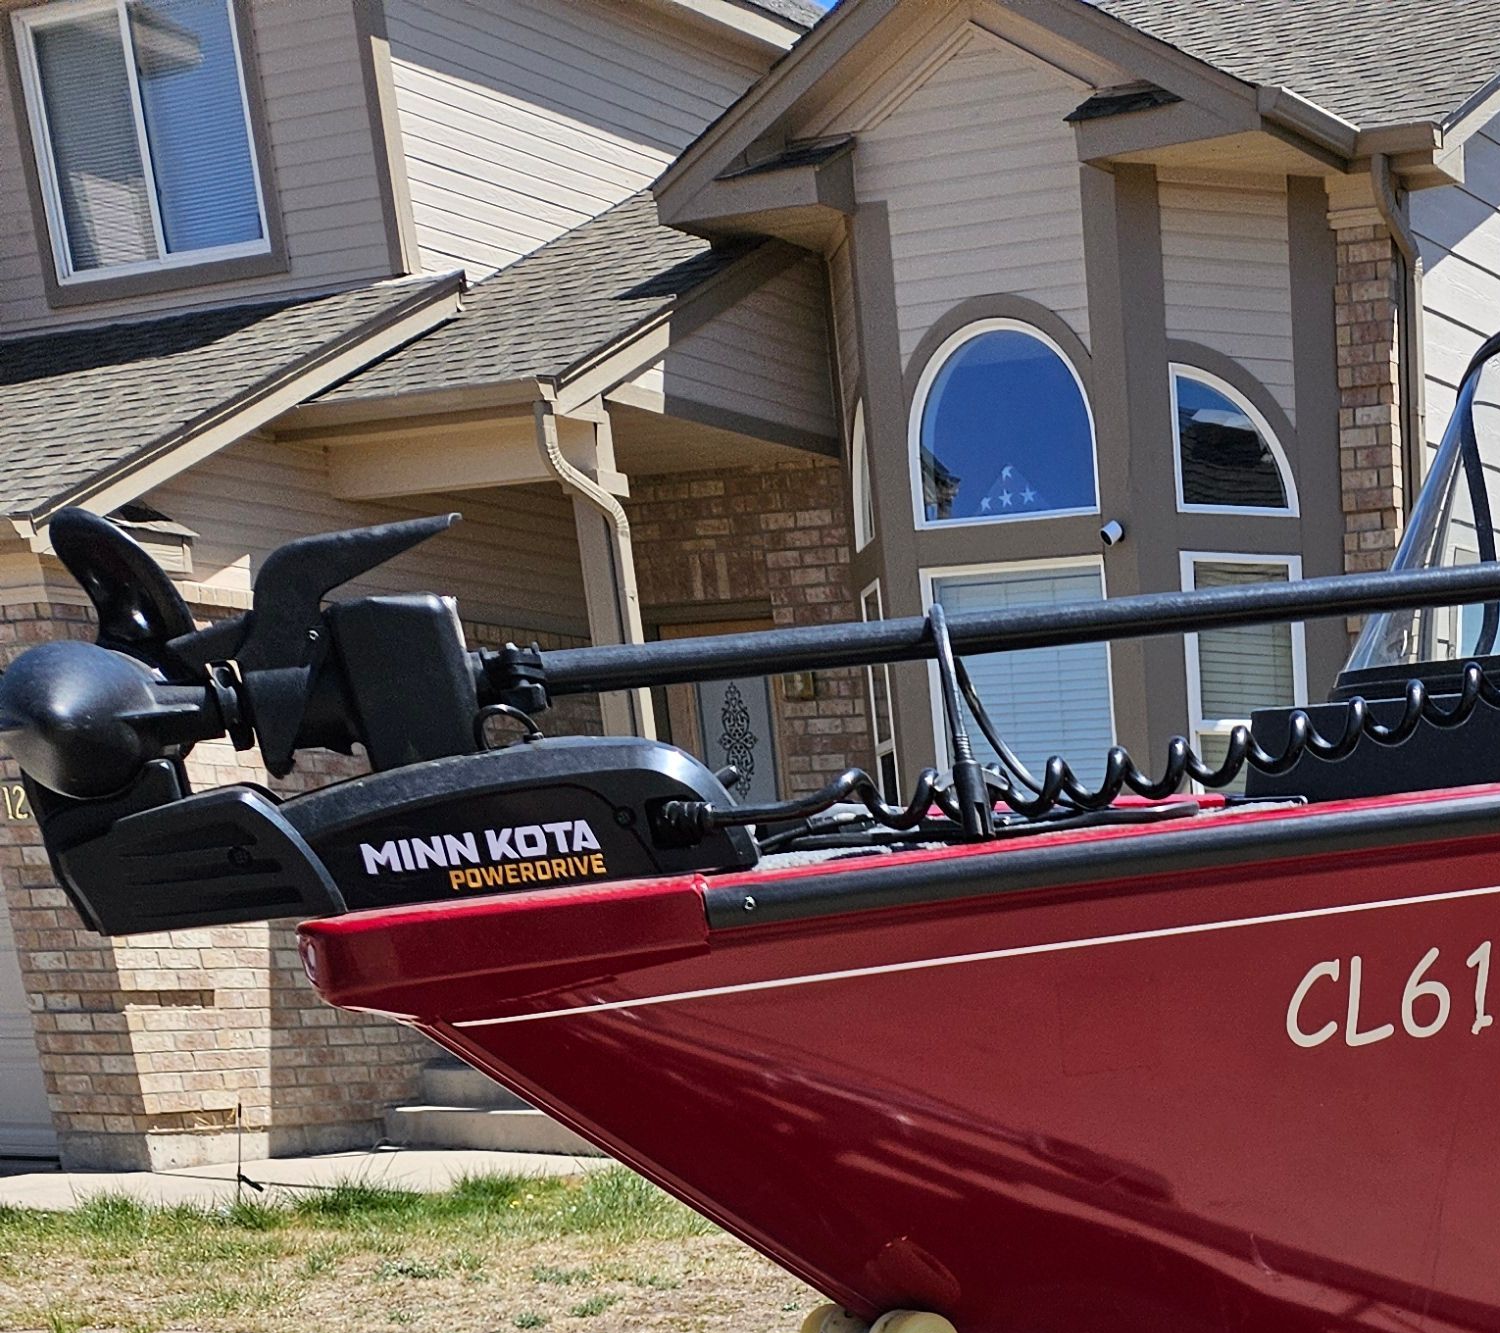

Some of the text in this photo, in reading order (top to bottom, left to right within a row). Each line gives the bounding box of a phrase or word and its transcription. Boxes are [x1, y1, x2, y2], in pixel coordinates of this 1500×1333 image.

[360, 819, 601, 875] MINN KOTA
[449, 853, 607, 890] POWERDRIVE
